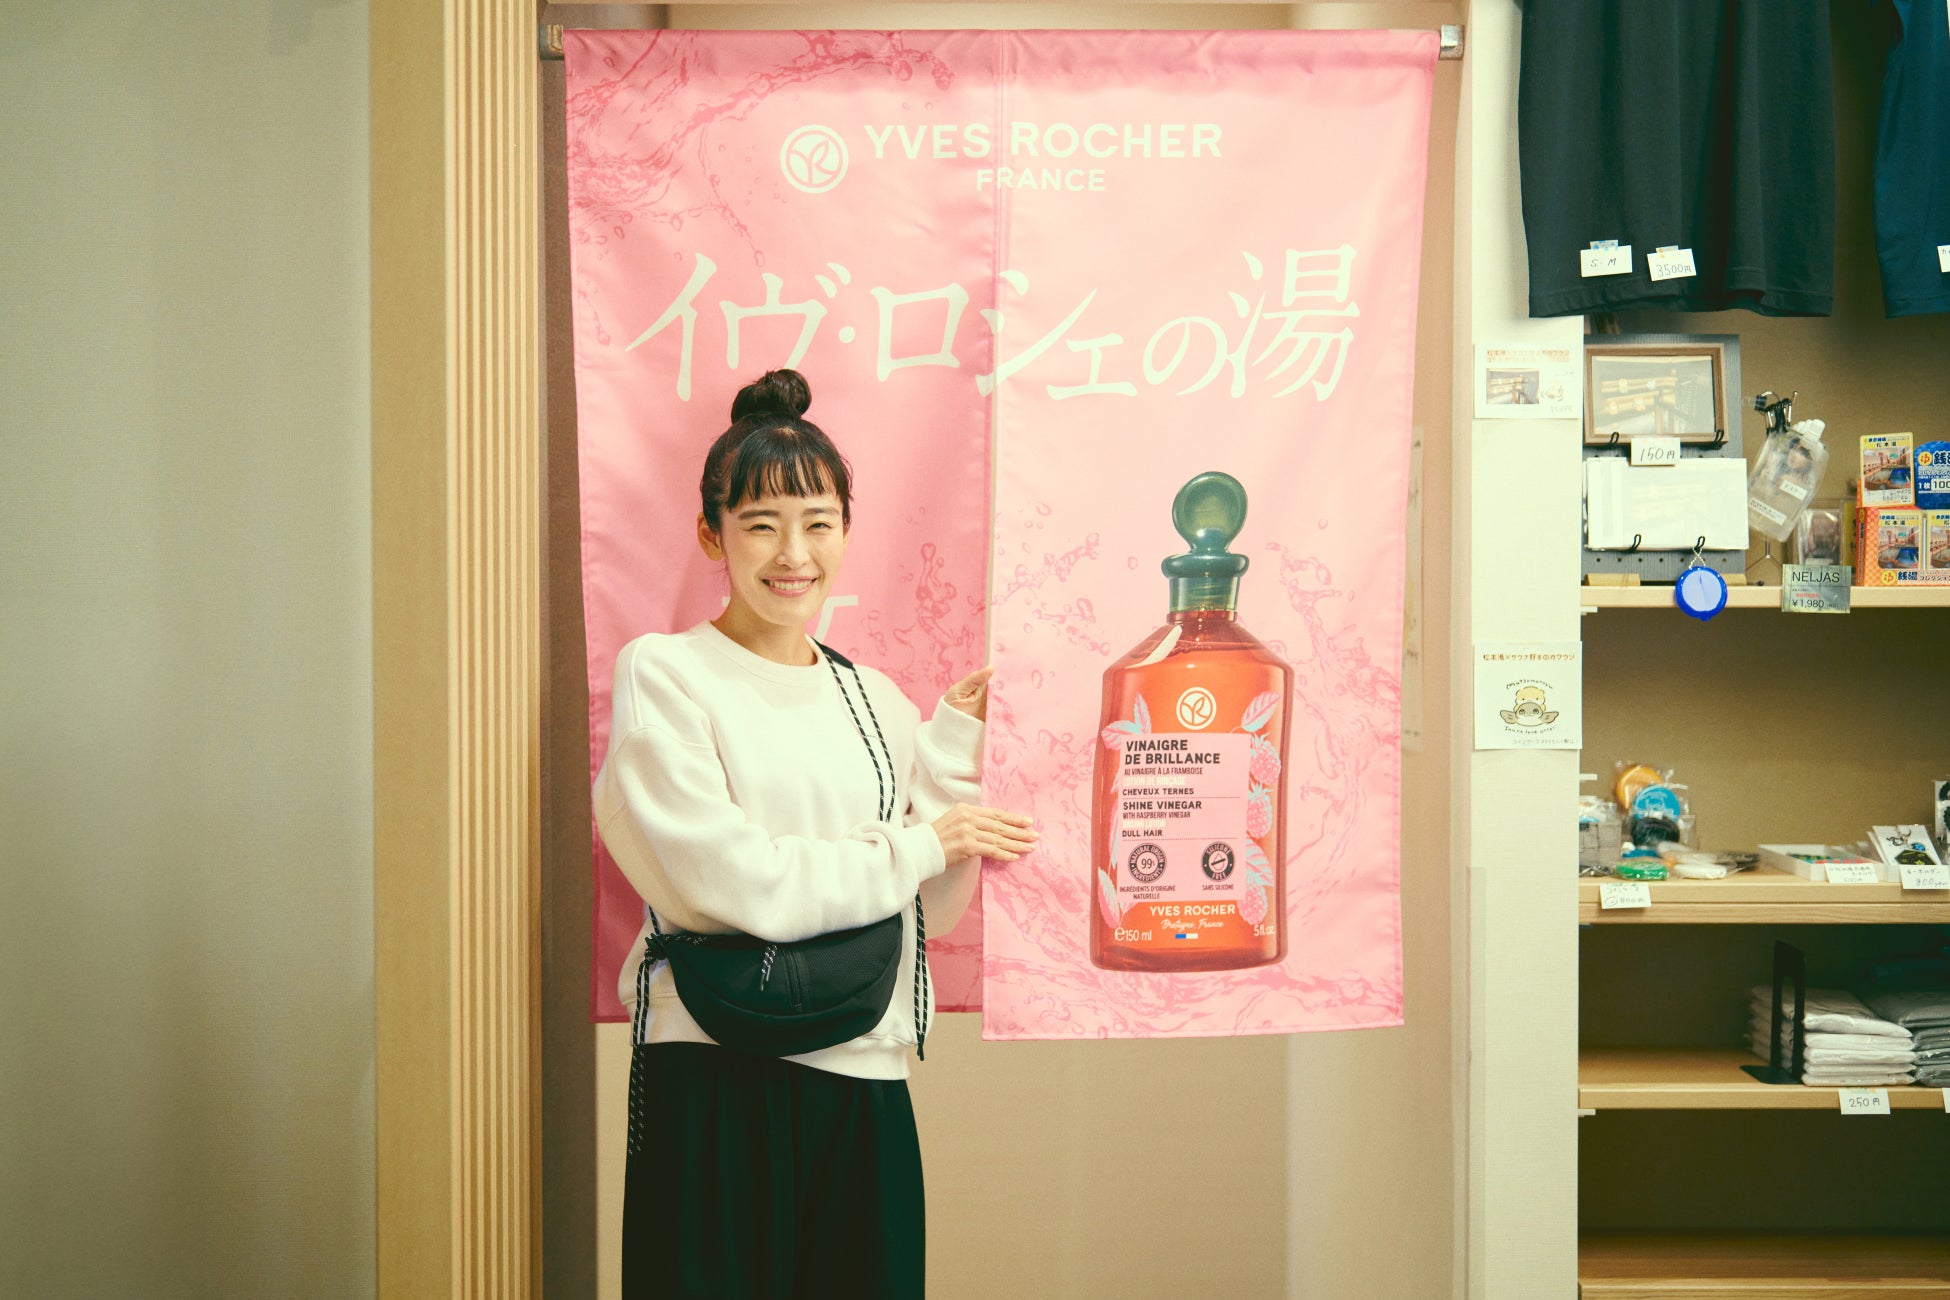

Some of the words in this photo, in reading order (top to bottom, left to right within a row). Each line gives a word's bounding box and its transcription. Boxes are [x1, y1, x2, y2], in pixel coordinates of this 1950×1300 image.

[865, 123, 990, 159] YVES
[1010, 122, 1223, 158] ROCHER
[976, 167, 1106, 192] FRANCE
[1933, 451, 1950, 465] 銭
[1792, 571, 1840, 583] NELJAS
[1126, 739, 1188, 752] VINAIGRE
[1125, 753, 1141, 765] DE
[1145, 752, 1221, 765] BRILLANCE
[1132, 766, 1156, 776] VINAIGRE
[1163, 766, 1170, 775] LA
[1170, 766, 1204, 776] FRAMBOISE
[1122, 787, 1160, 796] CHEVEUX
[1162, 787, 1195, 796] TERNES
[1122, 801, 1154, 811] SHINE
[1156, 800, 1202, 810] VINEGAR
[1123, 811, 1135, 819] WITH
[1136, 811, 1167, 819] RASPBERRY
[1168, 810, 1191, 819] VINEGAR
[1122, 829, 1141, 838] DULL
[1143, 829, 1163, 838] HAIR
[1149, 905, 1181, 917] YVES
[1183, 904, 1236, 916] ROCHER
[1141, 929, 1152, 941] ml
